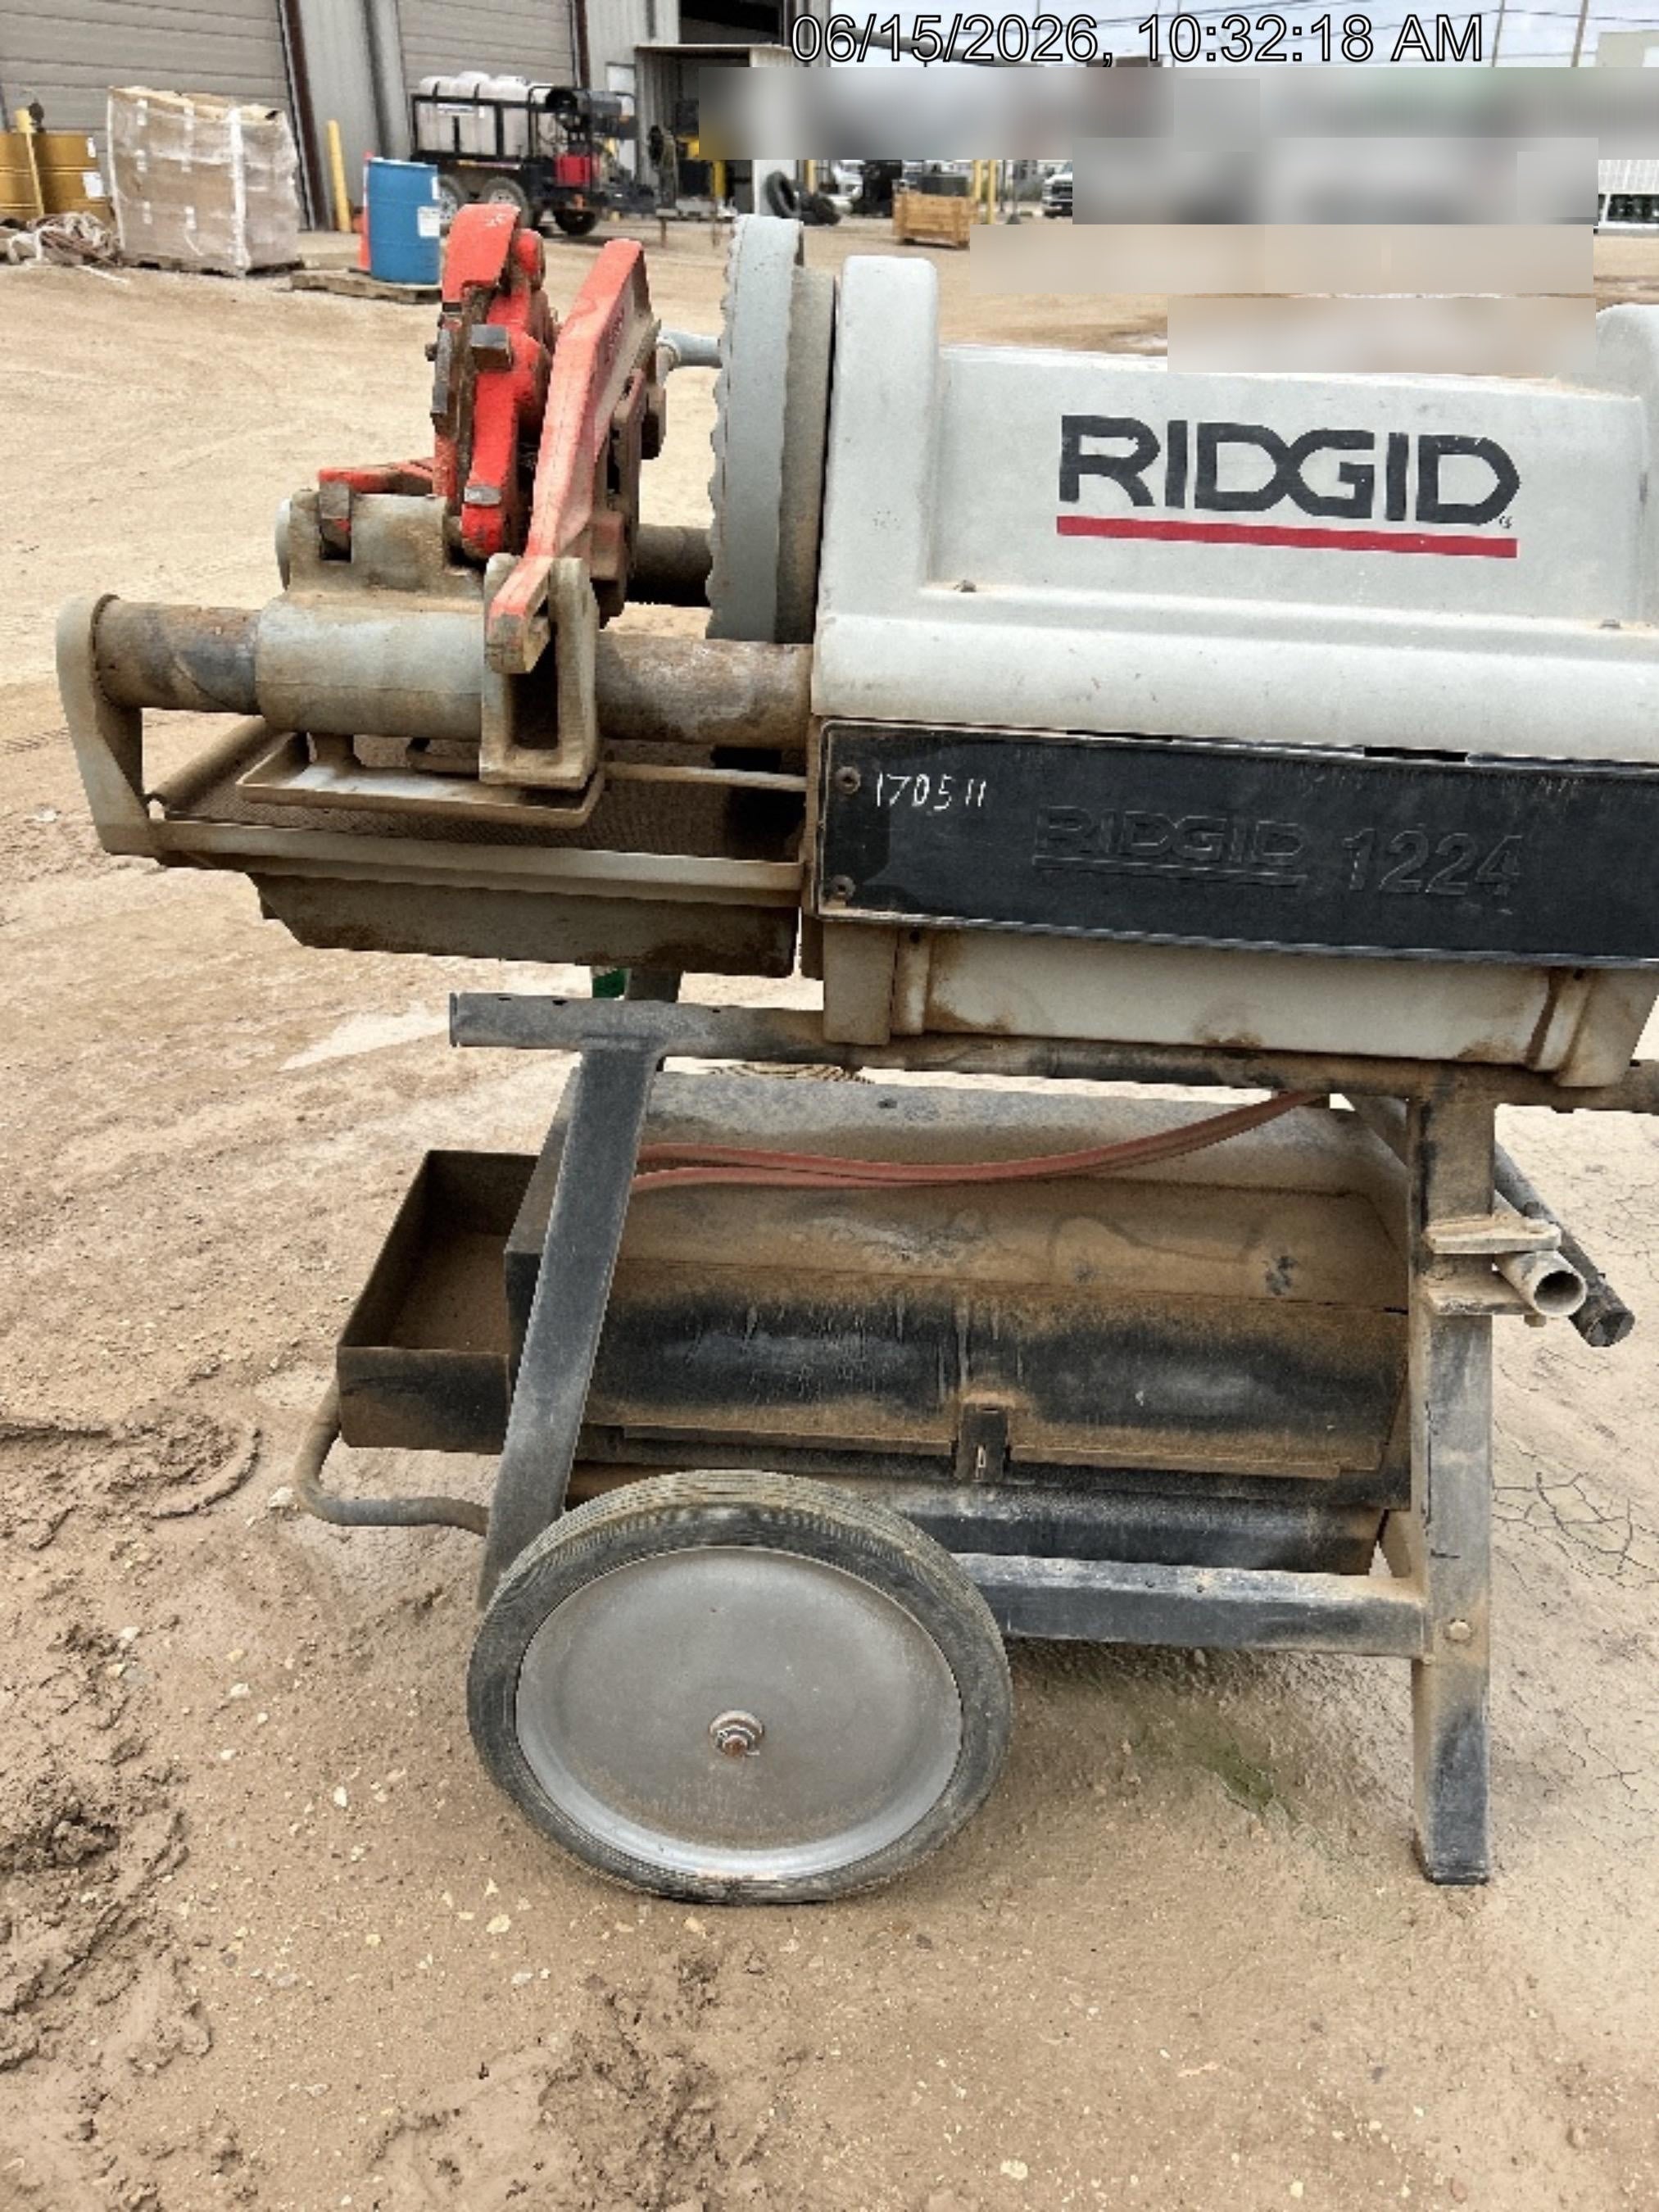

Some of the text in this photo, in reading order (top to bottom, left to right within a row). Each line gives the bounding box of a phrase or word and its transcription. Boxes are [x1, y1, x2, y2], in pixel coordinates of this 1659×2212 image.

[1058, 414, 1521, 525] RIDGID
[1034, 805, 1524, 897] RIDGID 1224
